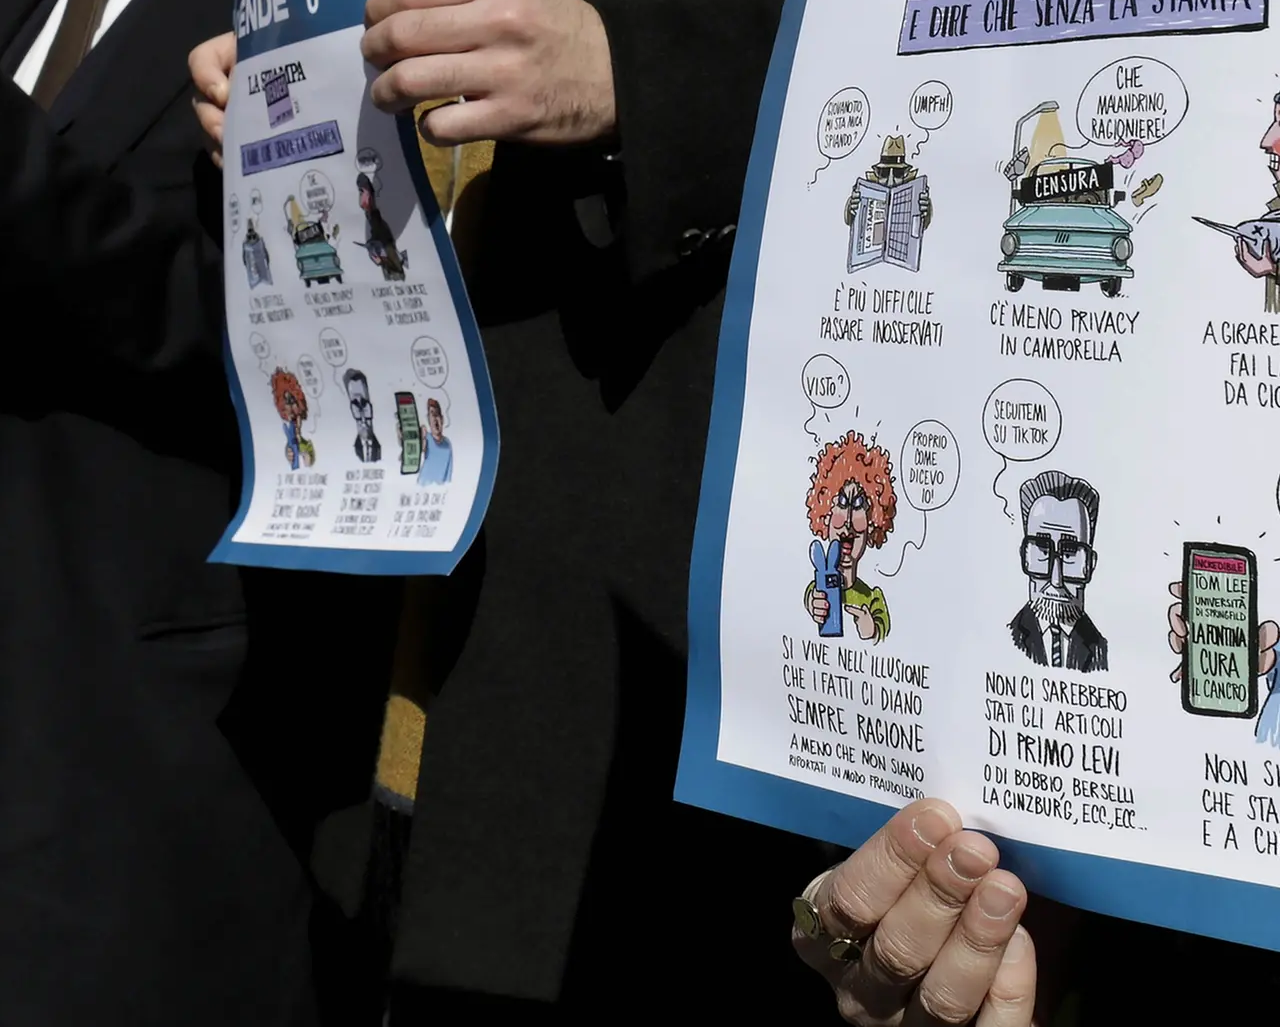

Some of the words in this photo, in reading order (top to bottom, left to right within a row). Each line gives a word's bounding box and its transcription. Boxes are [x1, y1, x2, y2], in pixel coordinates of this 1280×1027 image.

[909, 9, 921, 40] E
[929, 4, 969, 38] DIRE
[1116, 65, 1144, 90] CHE
[1096, 93, 1168, 115] MALANDRINO,
[835, 117, 846, 130] STA
[1091, 118, 1166, 140] RAGIONIERE!
[1035, 168, 1099, 198] CENSURA
[873, 288, 934, 315] DIFFICILE
[820, 317, 864, 342] PASSARE
[872, 320, 943, 347] INOSSERVATI
[1012, 303, 1062, 331] MENO
[1071, 309, 1140, 335] PRIVACY
[1202, 320, 1218, 345] A
[1221, 322, 1280, 347] GIRARE
[1000, 334, 1016, 356] IN
[1023, 336, 1123, 363] CAMPORELLA
[1230, 352, 1256, 376] FAI
[806, 374, 844, 398] VISTO?
[1224, 380, 1248, 407] DA
[994, 399, 1047, 422] SEGUITEMI
[912, 430, 948, 448] PROPRIO
[994, 423, 1007, 444] SU
[909, 468, 945, 485] DICEVO
[1194, 557, 1243, 572] INCREDIBILE
[1193, 573, 1220, 592] TOM
[1226, 577, 1248, 594] LEE
[1195, 607, 1203, 617] DI
[782, 635, 794, 659] SI
[802, 640, 830, 666] VIVE
[1200, 648, 1240, 678] CURA
[783, 664, 805, 690] CHE
[813, 670, 817, 691] I
[821, 672, 854, 700] FATTI
[861, 681, 873, 706] CI
[881, 686, 923, 716] DIANO
[985, 671, 1016, 697] NON
[1020, 675, 1034, 700] CI
[1042, 677, 1128, 712] SAREBBERO
[1192, 677, 1201, 697] IL
[1204, 679, 1247, 702] CANCRO
[787, 693, 848, 735] SEMPRE
[857, 713, 925, 752] RAGIONE
[985, 698, 1014, 723] STATI
[1022, 705, 1043, 729] GLI
[1055, 710, 1123, 738] ARTICOLI
[790, 733, 799, 750] A
[800, 736, 832, 757] MENO
[836, 743, 856, 764] CHE
[861, 750, 887, 771] NON
[891, 758, 924, 783] SIANO
[989, 726, 1006, 757] DI
[1017, 732, 1074, 768] PRIMO
[1082, 744, 1120, 777] LEVI
[789, 755, 826, 774] RIPORTATI
[831, 766, 841, 778] IN
[842, 769, 866, 785] MODO
[984, 764, 992, 782] O
[995, 766, 1007, 784] DI
[1014, 769, 1065, 801] BOBBIO,
[1072, 777, 1135, 804] BERSELLI
[1205, 753, 1248, 786] NON
[1264, 760, 1280, 787] SI
[982, 786, 999, 806] LA
[1003, 790, 1078, 825] GINZBURG,
[1202, 788, 1235, 817] CHE
[1247, 794, 1280, 824] STA
[1203, 820, 1212, 847] E
[1224, 823, 1239, 850] A
